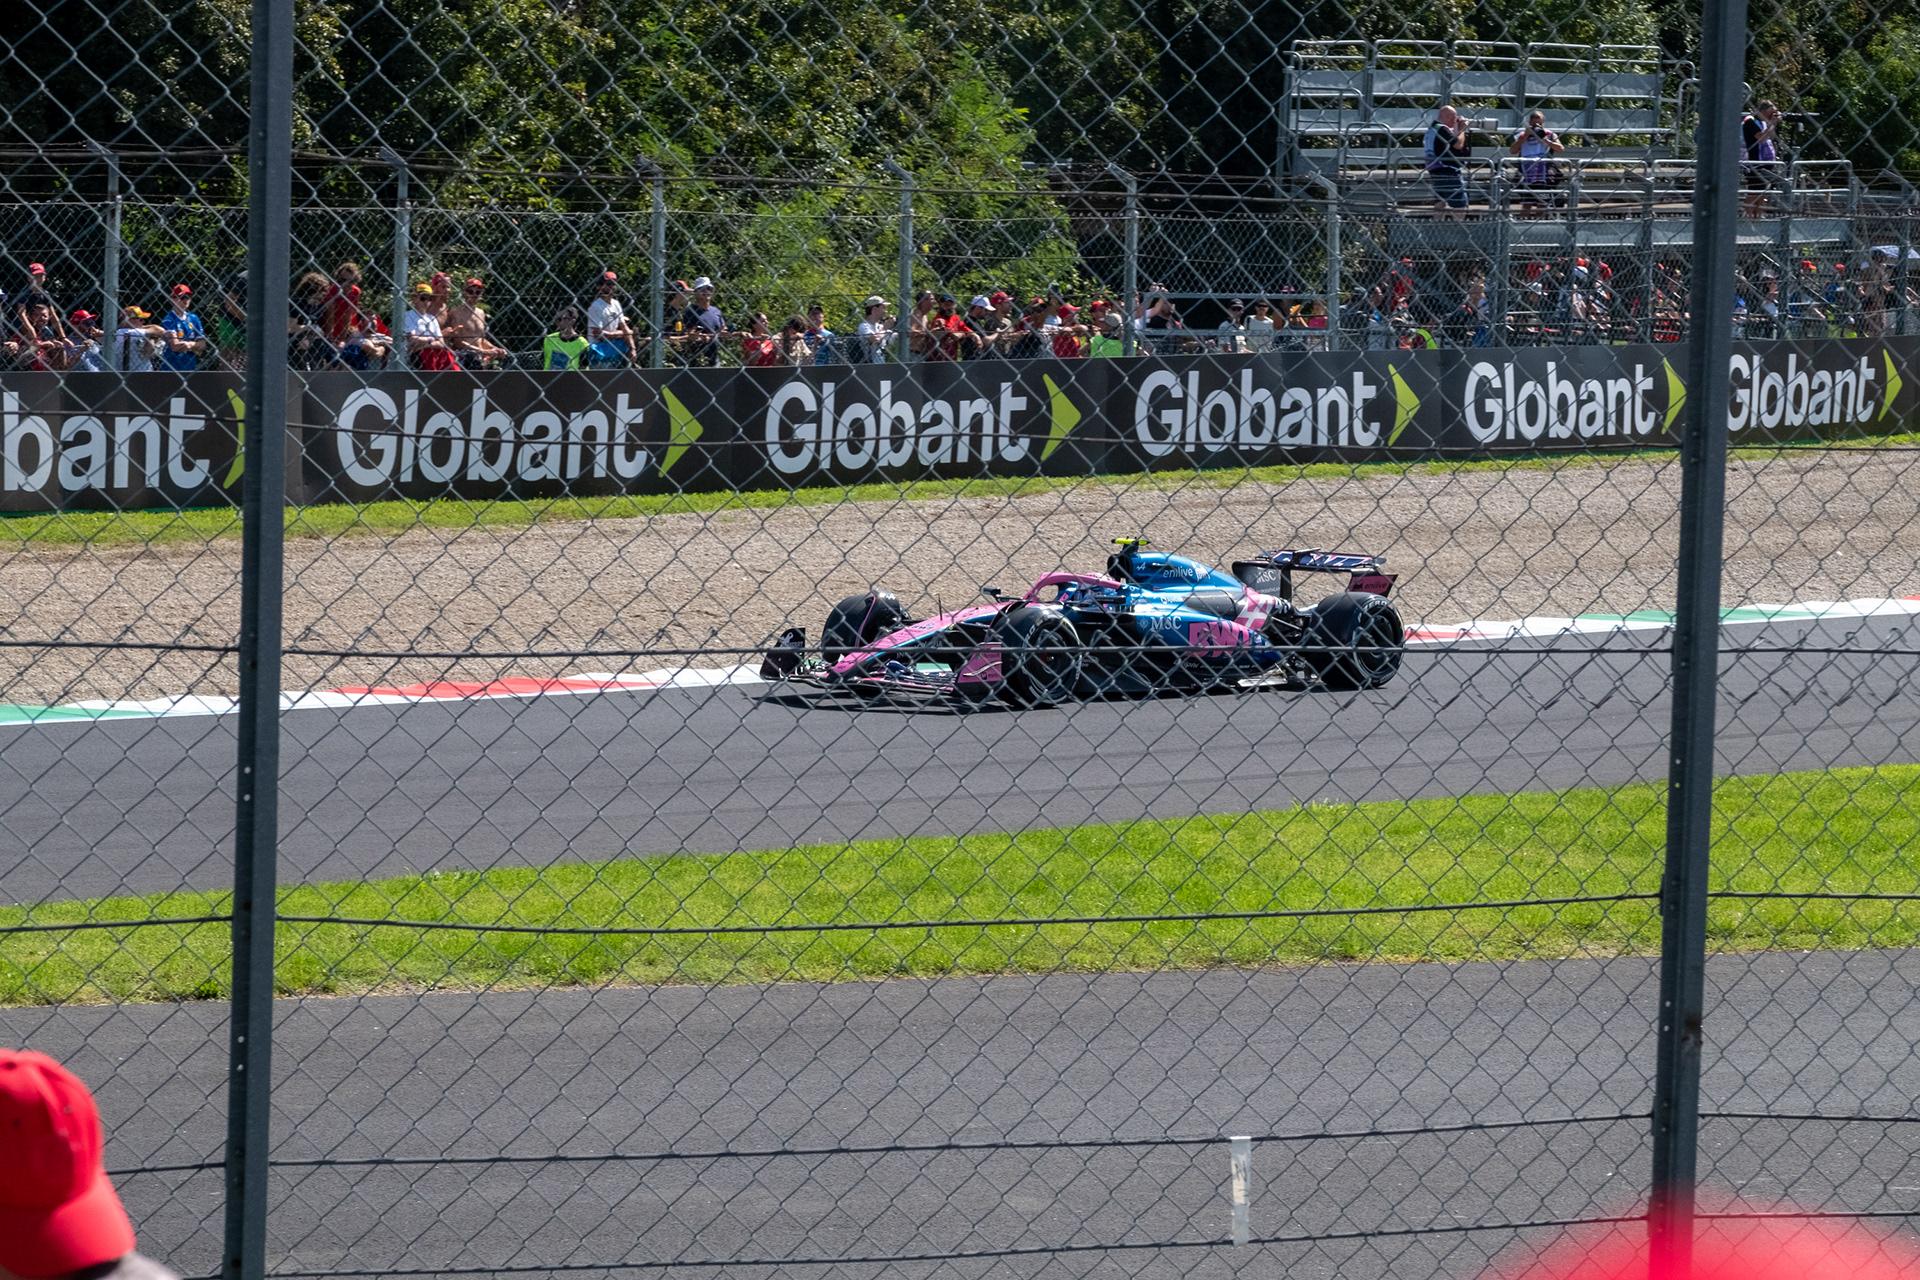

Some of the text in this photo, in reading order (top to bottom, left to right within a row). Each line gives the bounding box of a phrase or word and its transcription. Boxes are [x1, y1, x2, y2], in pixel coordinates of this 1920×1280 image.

[337, 388, 647, 487] Globant
[765, 380, 1030, 474] Globant
[1135, 368, 1380, 457] Globant
[1464, 361, 1656, 444] Globant
[1726, 353, 1875, 432] Globant
[3, 391, 209, 492] bant
